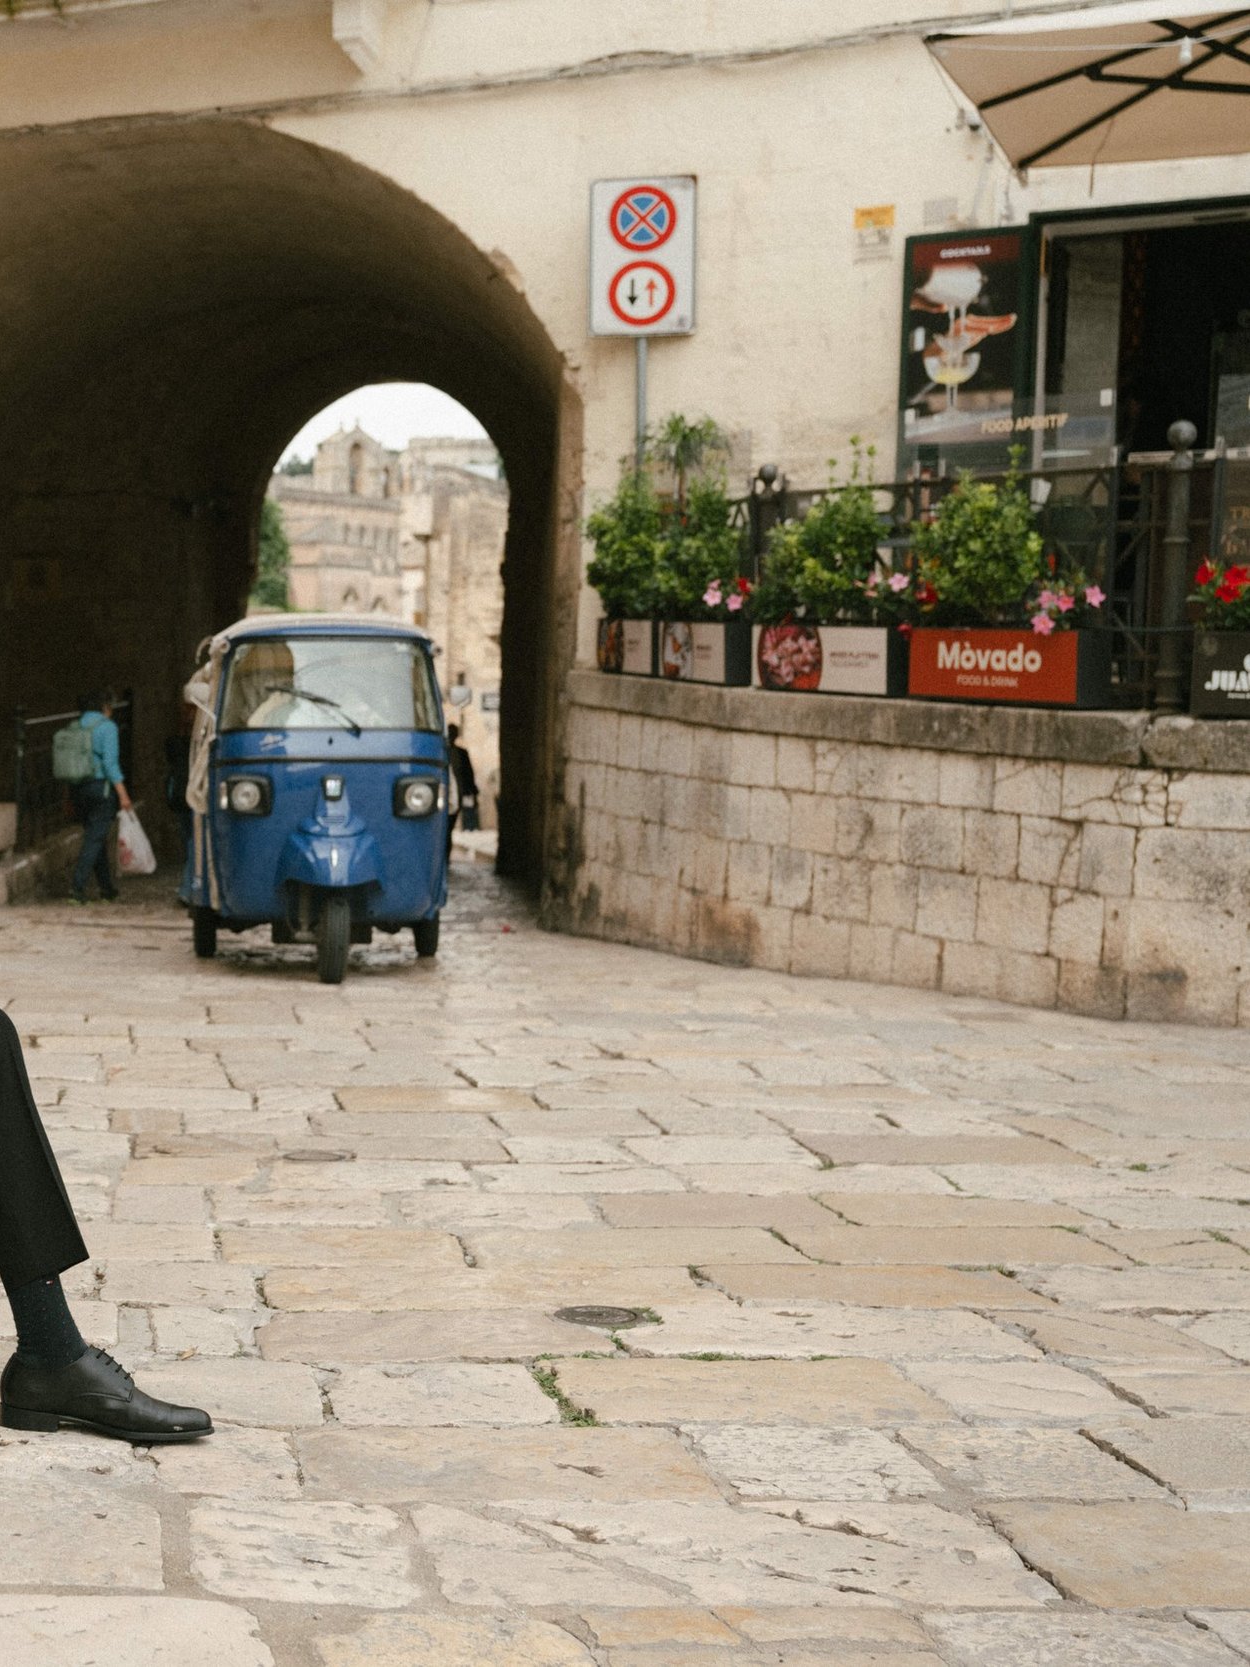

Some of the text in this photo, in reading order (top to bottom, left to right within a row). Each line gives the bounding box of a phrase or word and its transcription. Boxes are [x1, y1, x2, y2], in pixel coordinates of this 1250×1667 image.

[937, 640, 1042, 673] Mòvado
[956, 674, 982, 687] FOOD
[991, 676, 1018, 688] DRINK
[1204, 670, 1250, 691] JUA
